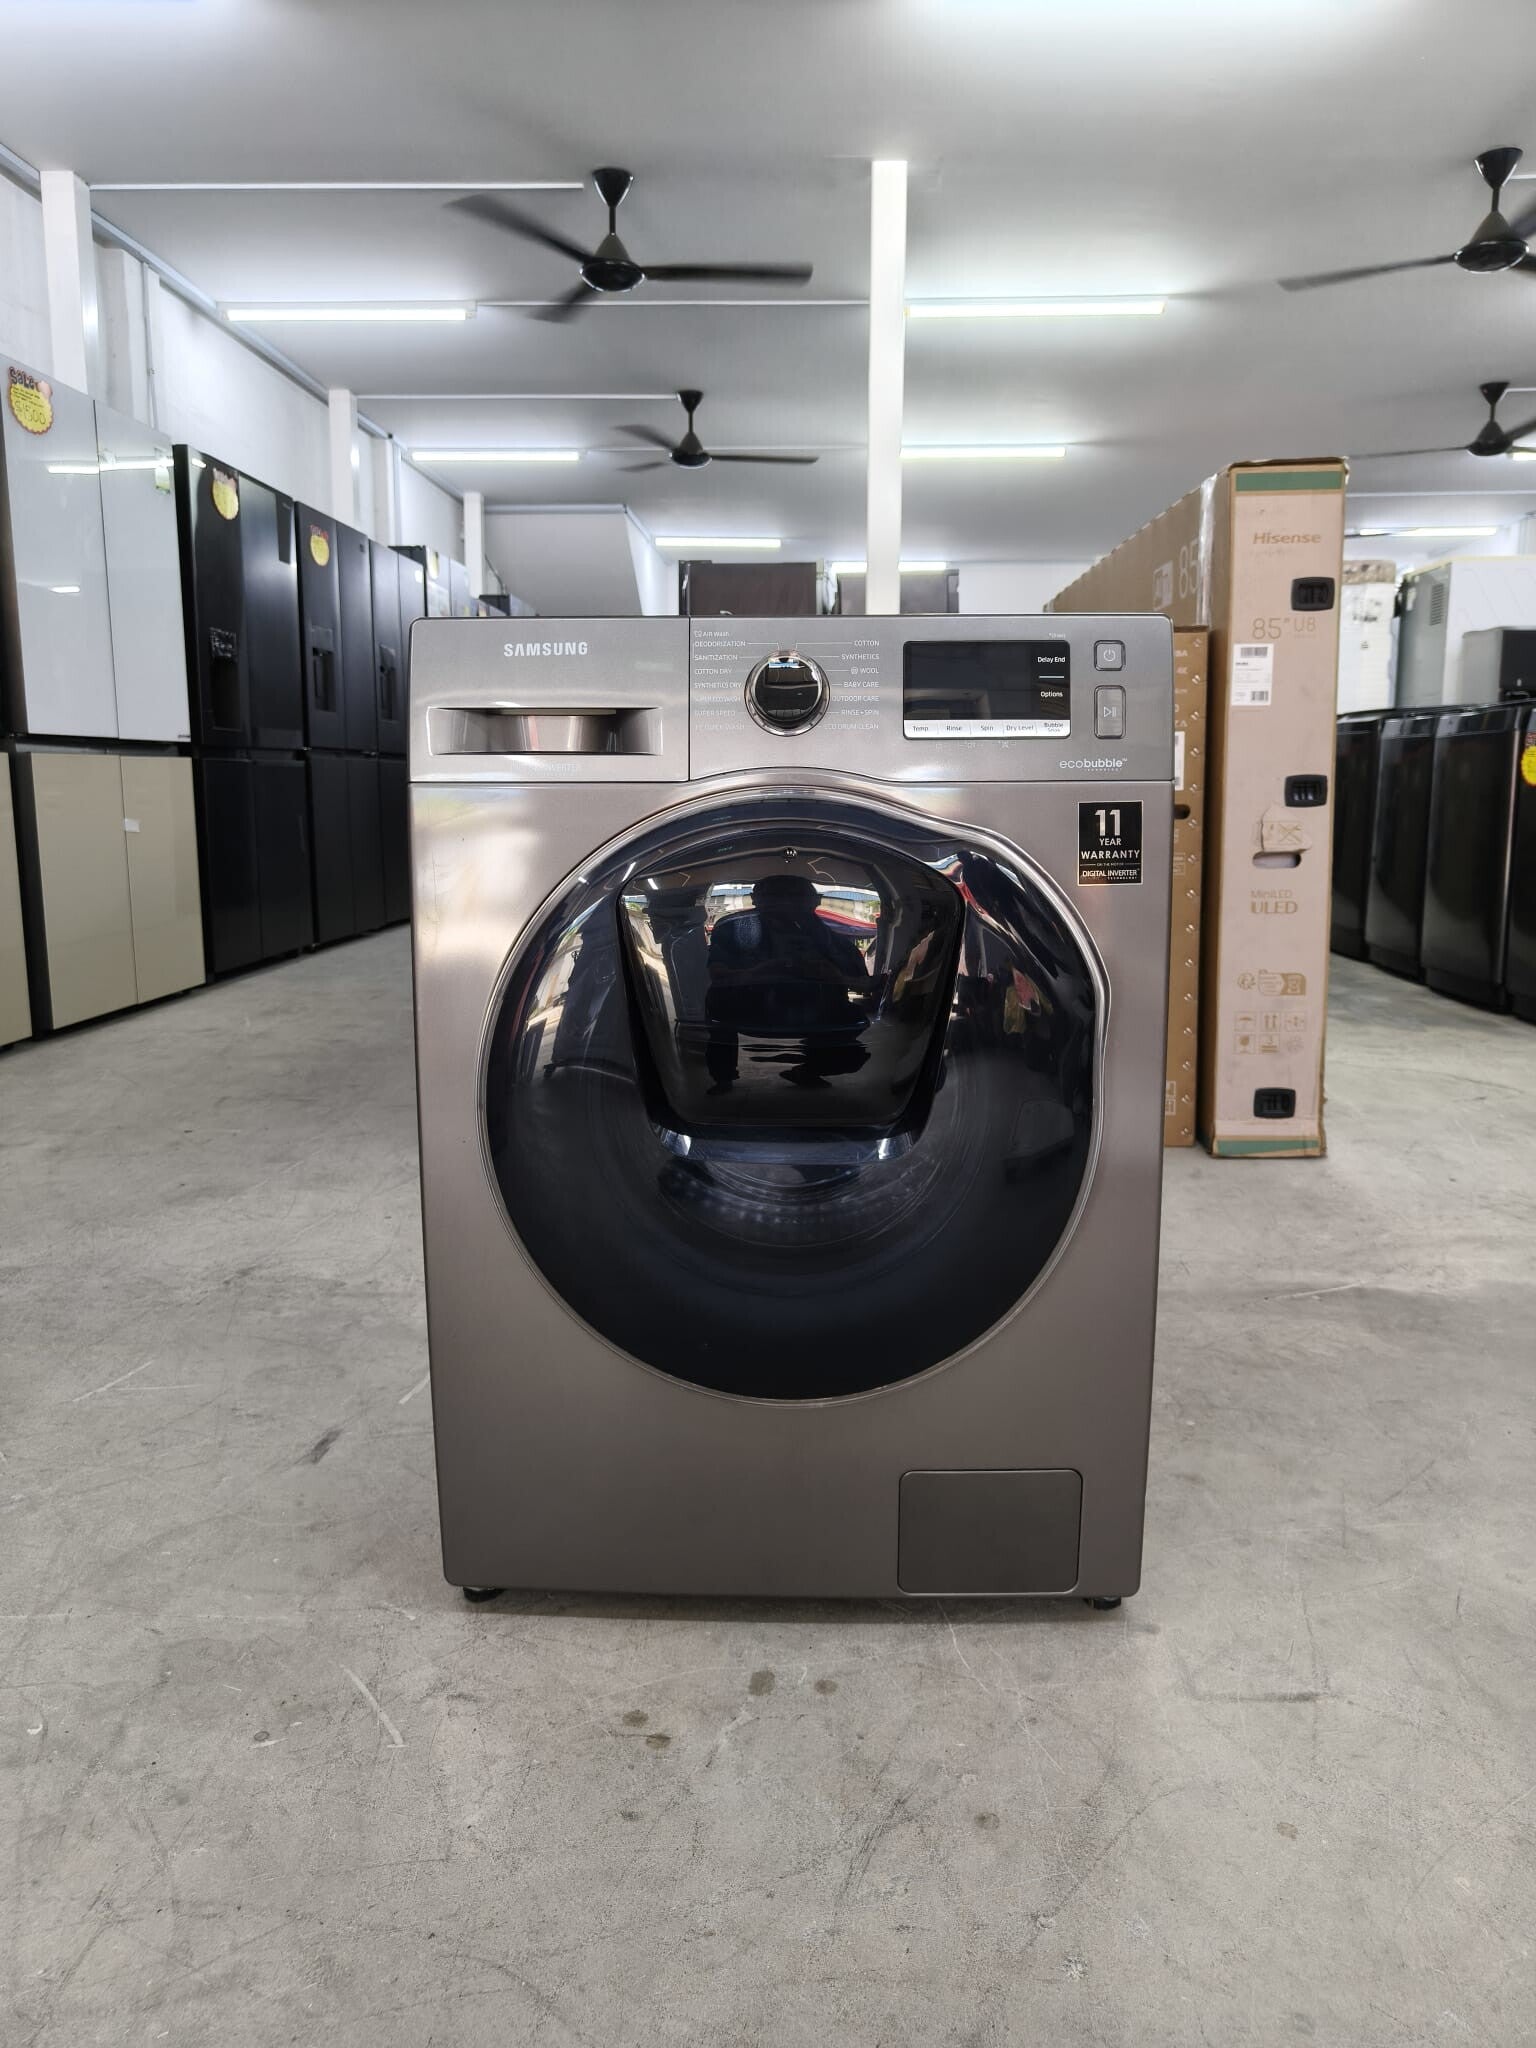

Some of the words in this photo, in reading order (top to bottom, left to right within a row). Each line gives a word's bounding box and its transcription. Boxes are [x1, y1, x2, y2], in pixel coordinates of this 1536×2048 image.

[1253, 532, 1322, 545] Hisense
[694, 640, 746, 648] DEODORIZATION
[503, 641, 588, 657] SAMSUNG
[1037, 656, 1054, 664] Delay
[1040, 690, 1064, 698] Options
[1094, 809, 1121, 837] 11
[1099, 838, 1122, 846] YEAR
[1081, 850, 1140, 860] WARRANTY
[1082, 870, 1107, 878] DIGITAL
[1107, 869, 1138, 877] INVERTER
[1250, 901, 1298, 914] ULED
